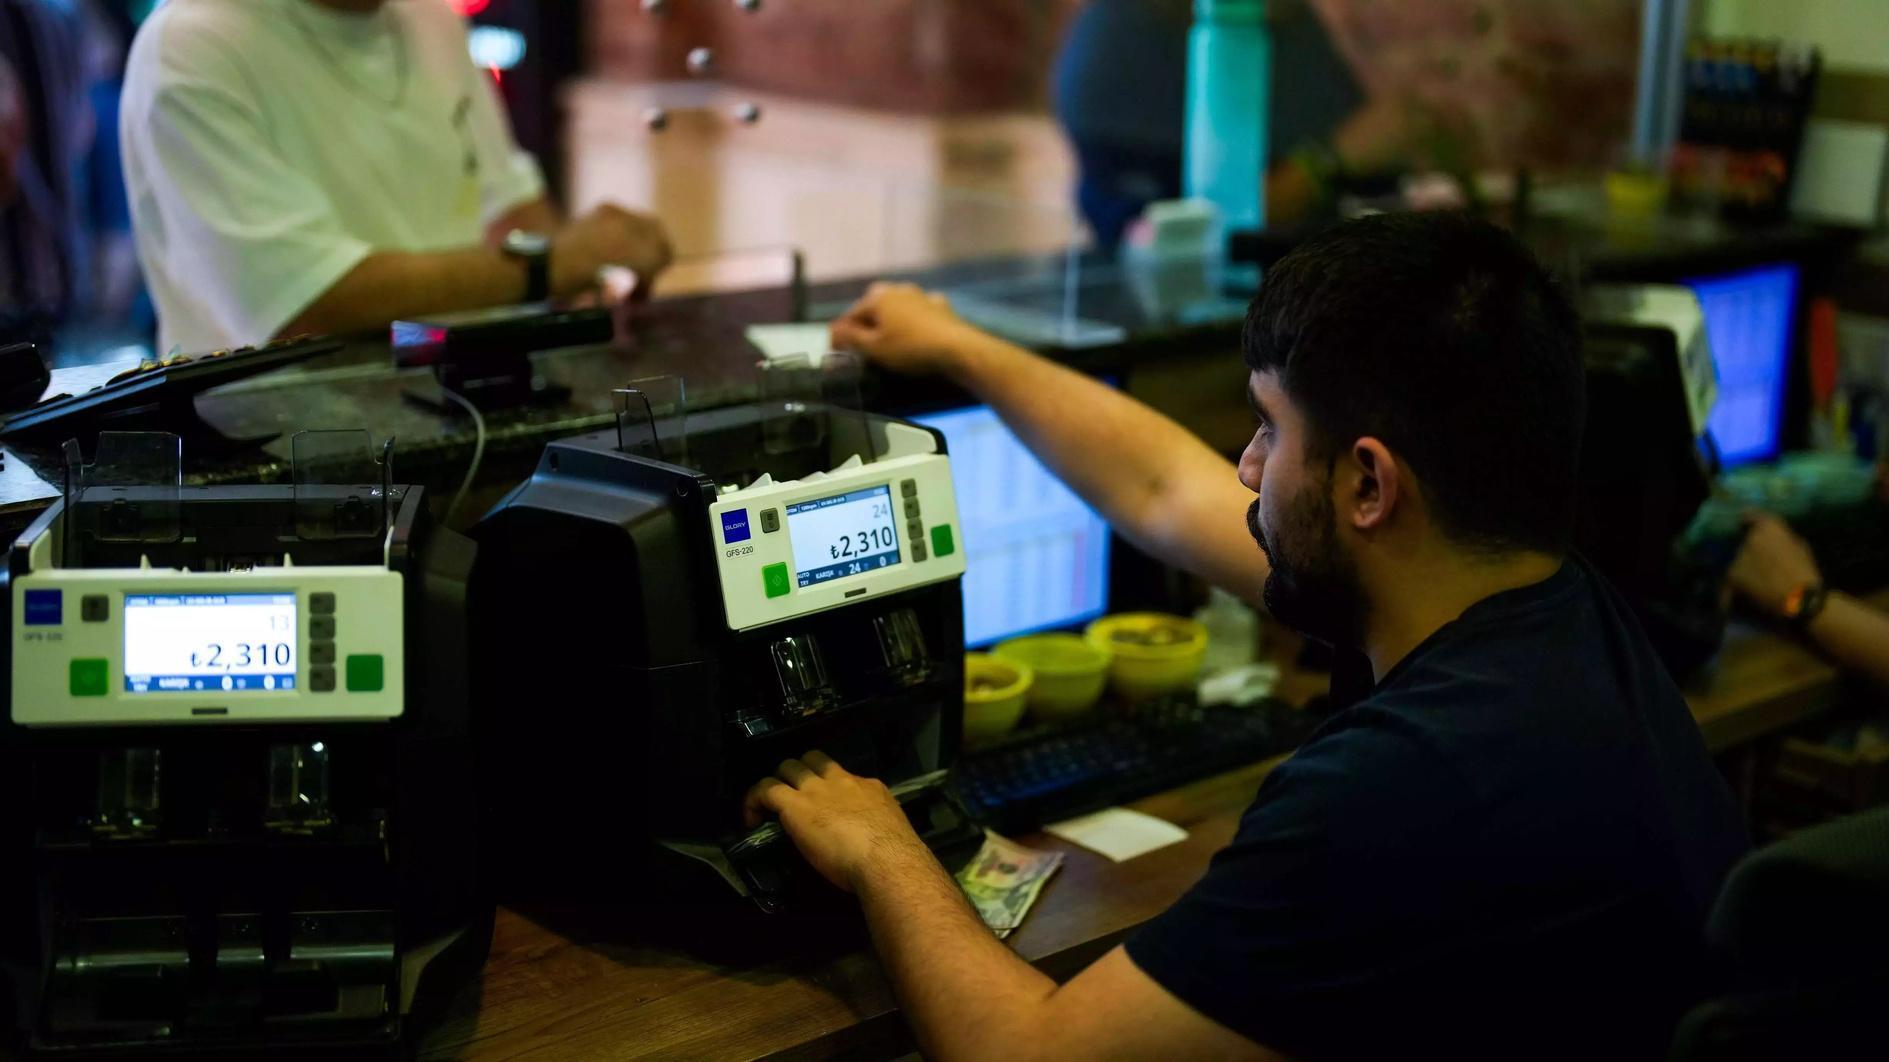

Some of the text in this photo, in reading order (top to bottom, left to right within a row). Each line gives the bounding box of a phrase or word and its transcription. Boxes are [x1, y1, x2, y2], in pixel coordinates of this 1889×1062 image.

[872, 502, 888, 519] 24
[724, 521, 747, 531] GLORY
[726, 546, 754, 558] GFS-220
[848, 561, 861, 575] 24
